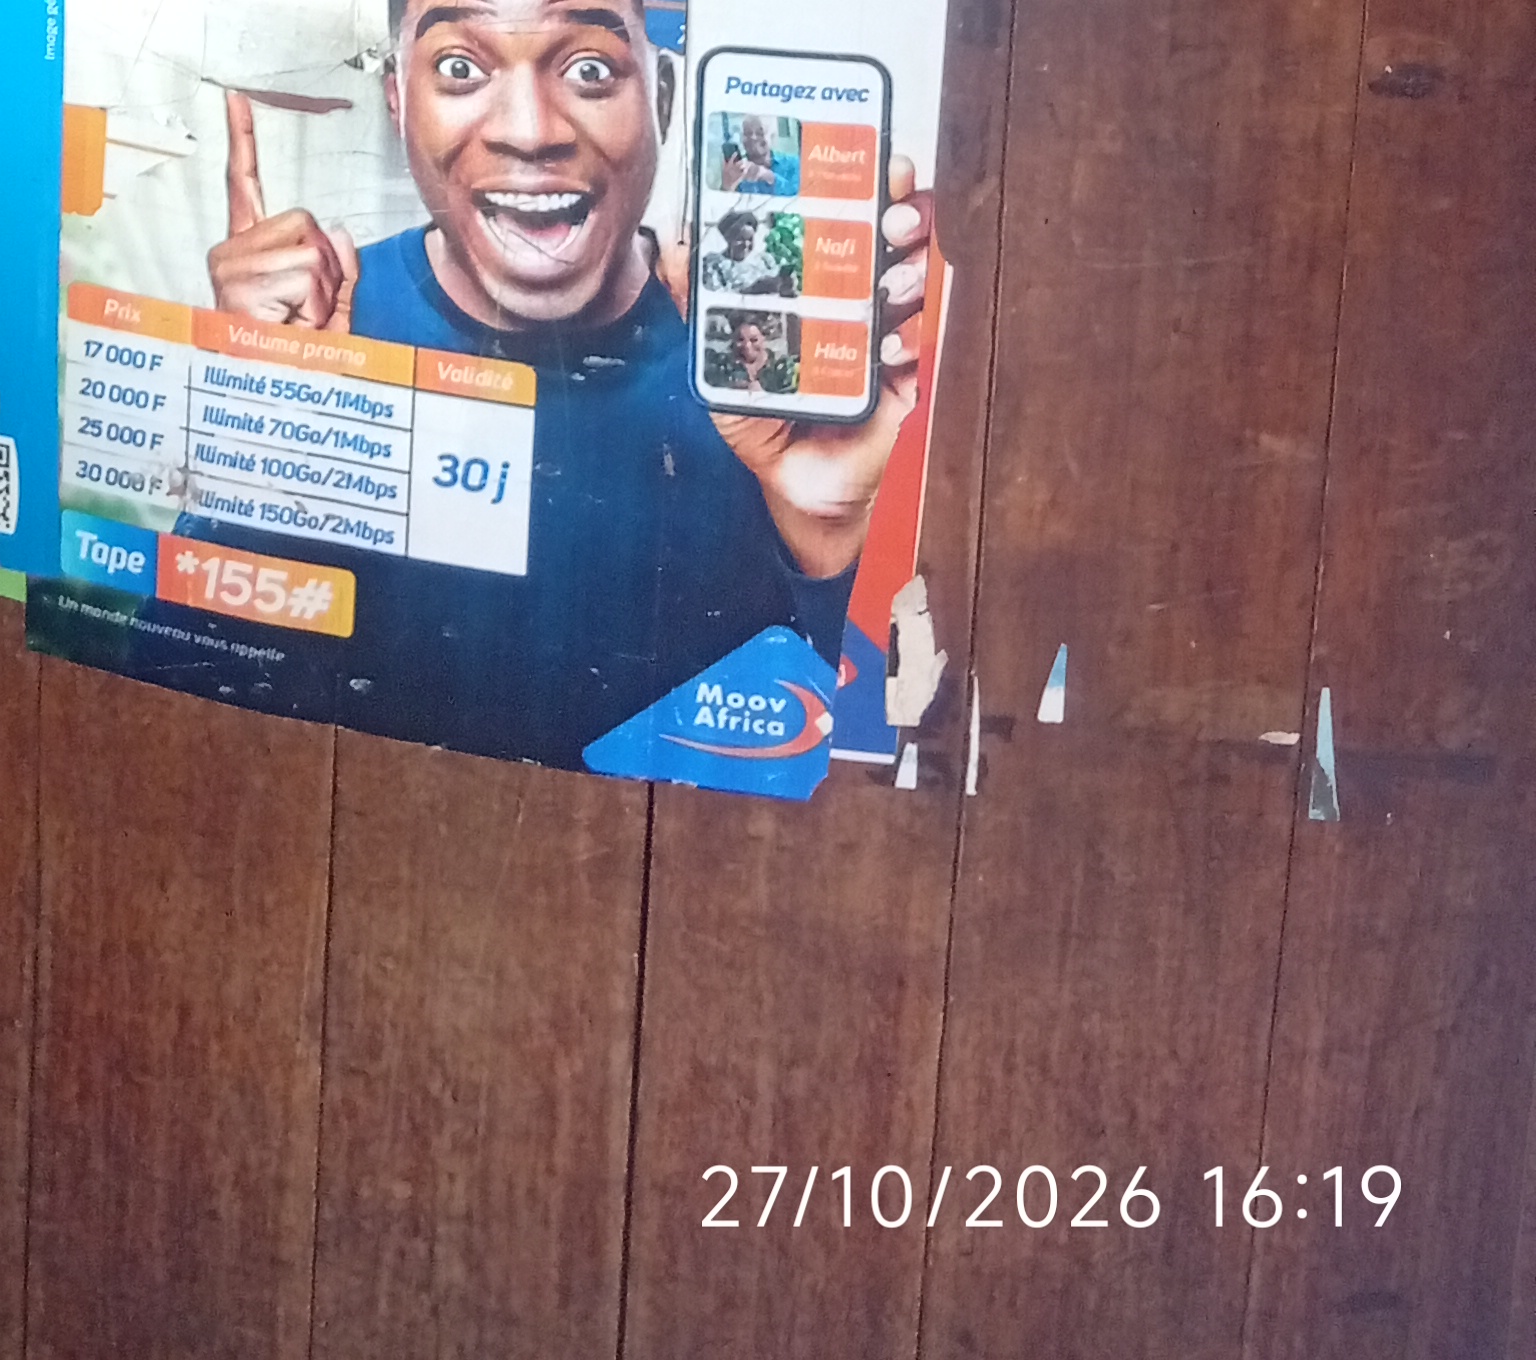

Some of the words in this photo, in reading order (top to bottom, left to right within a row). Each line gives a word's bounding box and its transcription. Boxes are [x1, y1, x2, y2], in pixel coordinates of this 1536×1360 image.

[44, 17, 58, 61] Image
[725, 76, 817, 104] Partagez
[820, 84, 870, 103] avec
[808, 144, 866, 165] Albert
[815, 237, 857, 259] Nafi
[103, 298, 142, 323] Prix
[83, 340, 103, 358] 17
[105, 345, 146, 369] 000
[149, 354, 163, 371] F
[228, 325, 300, 355] Volume
[302, 345, 367, 367] promo
[204, 365, 266, 394] Illimité
[269, 379, 394, 419] 55Go/1Mbps
[437, 361, 514, 391] Validité
[79, 378, 105, 399] 20
[109, 385, 149, 409] 000
[152, 394, 166, 411] F
[78, 417, 103, 438] 25
[106, 423, 146, 448] 000
[149, 433, 164, 450] F
[202, 404, 264, 434] Illimité
[268, 418, 392, 459] 70Go/1Mbps
[75, 460, 102, 482] 30
[105, 467, 145, 492] 000
[148, 477, 163, 495] F
[194, 443, 256, 472] Illimité
[261, 457, 397, 500] 100Go/2Mbps
[432, 452, 490, 492] 30
[490, 460, 511, 505] j
[259, 503, 395, 545] 150Go/2Mbps
[75, 530, 146, 574] Tape
[58, 594, 79, 612] Un
[80, 603, 128, 624] monde
[130, 610, 191, 641] nouveau
[193, 632, 228, 651] vous
[695, 682, 787, 713] Moov
[693, 705, 785, 737] Africa
